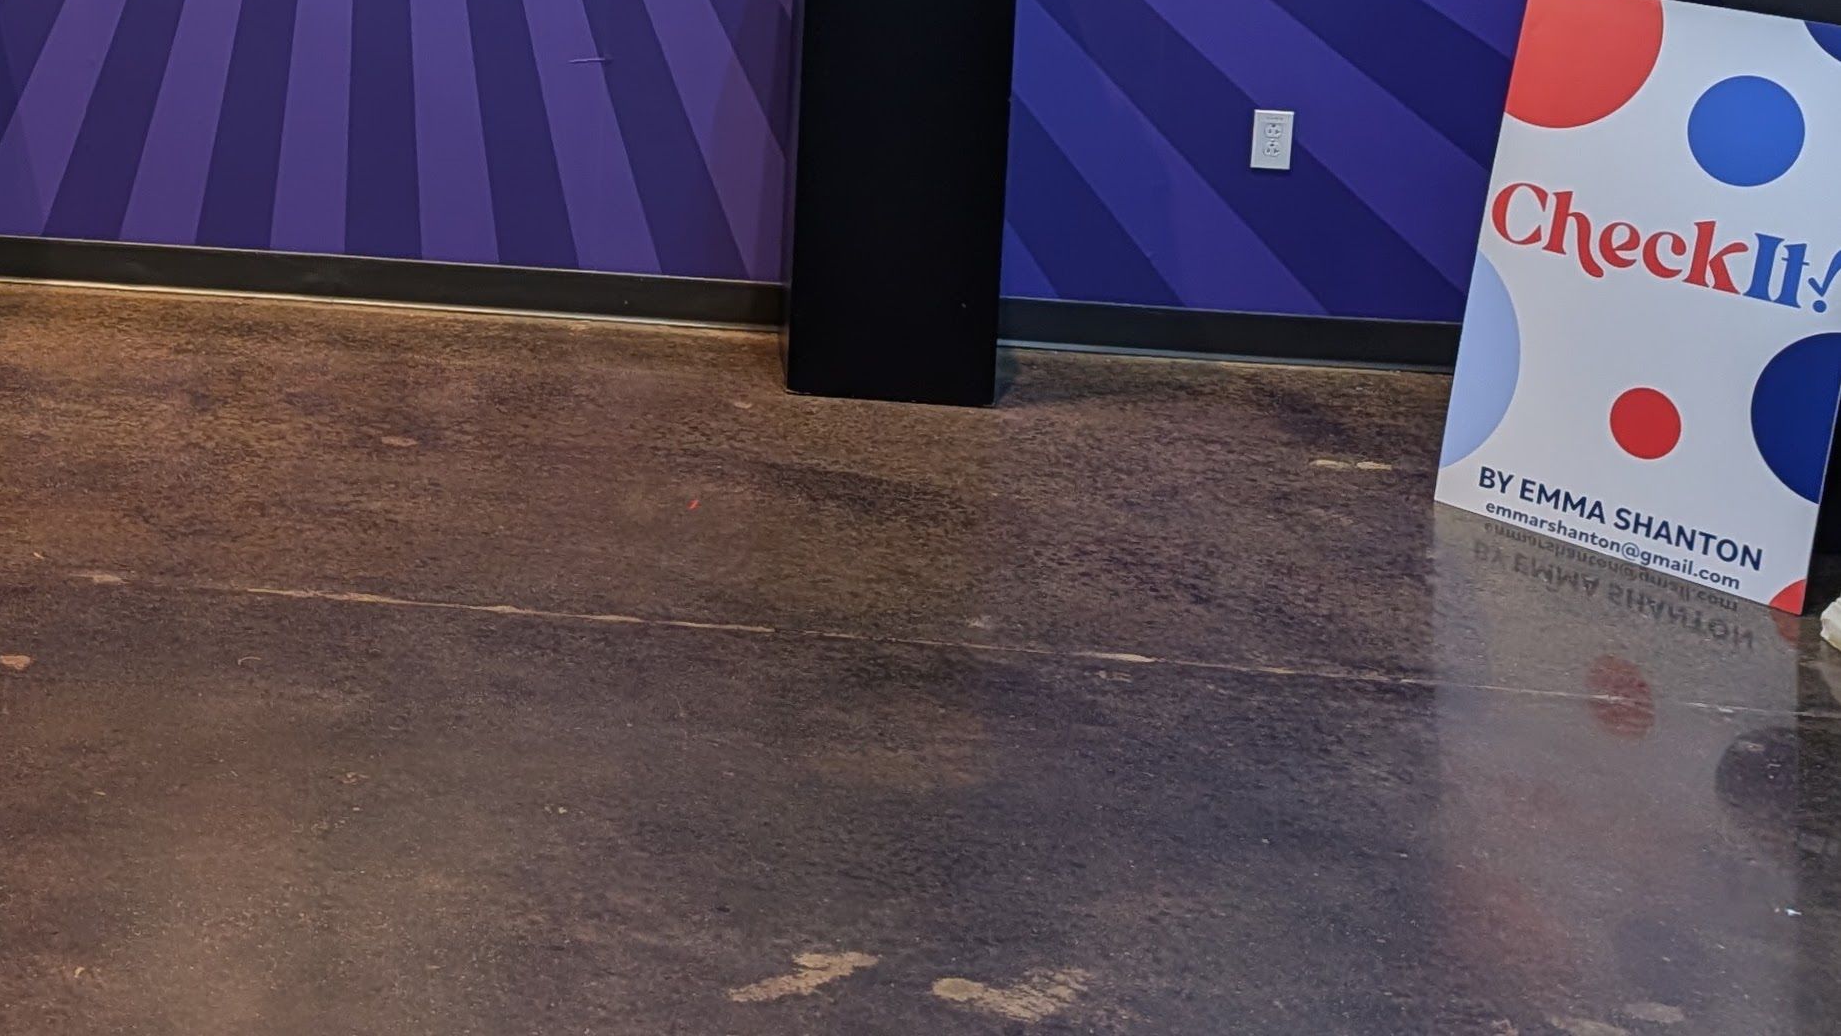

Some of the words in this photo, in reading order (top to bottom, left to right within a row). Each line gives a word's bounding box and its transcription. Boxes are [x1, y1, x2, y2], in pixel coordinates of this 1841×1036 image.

[1478, 466, 1514, 494] BY
[1519, 478, 1606, 524] EMMA
[1613, 507, 1763, 571] SHANTON
[1485, 502, 1740, 590] emmarshanton@gmail.com
